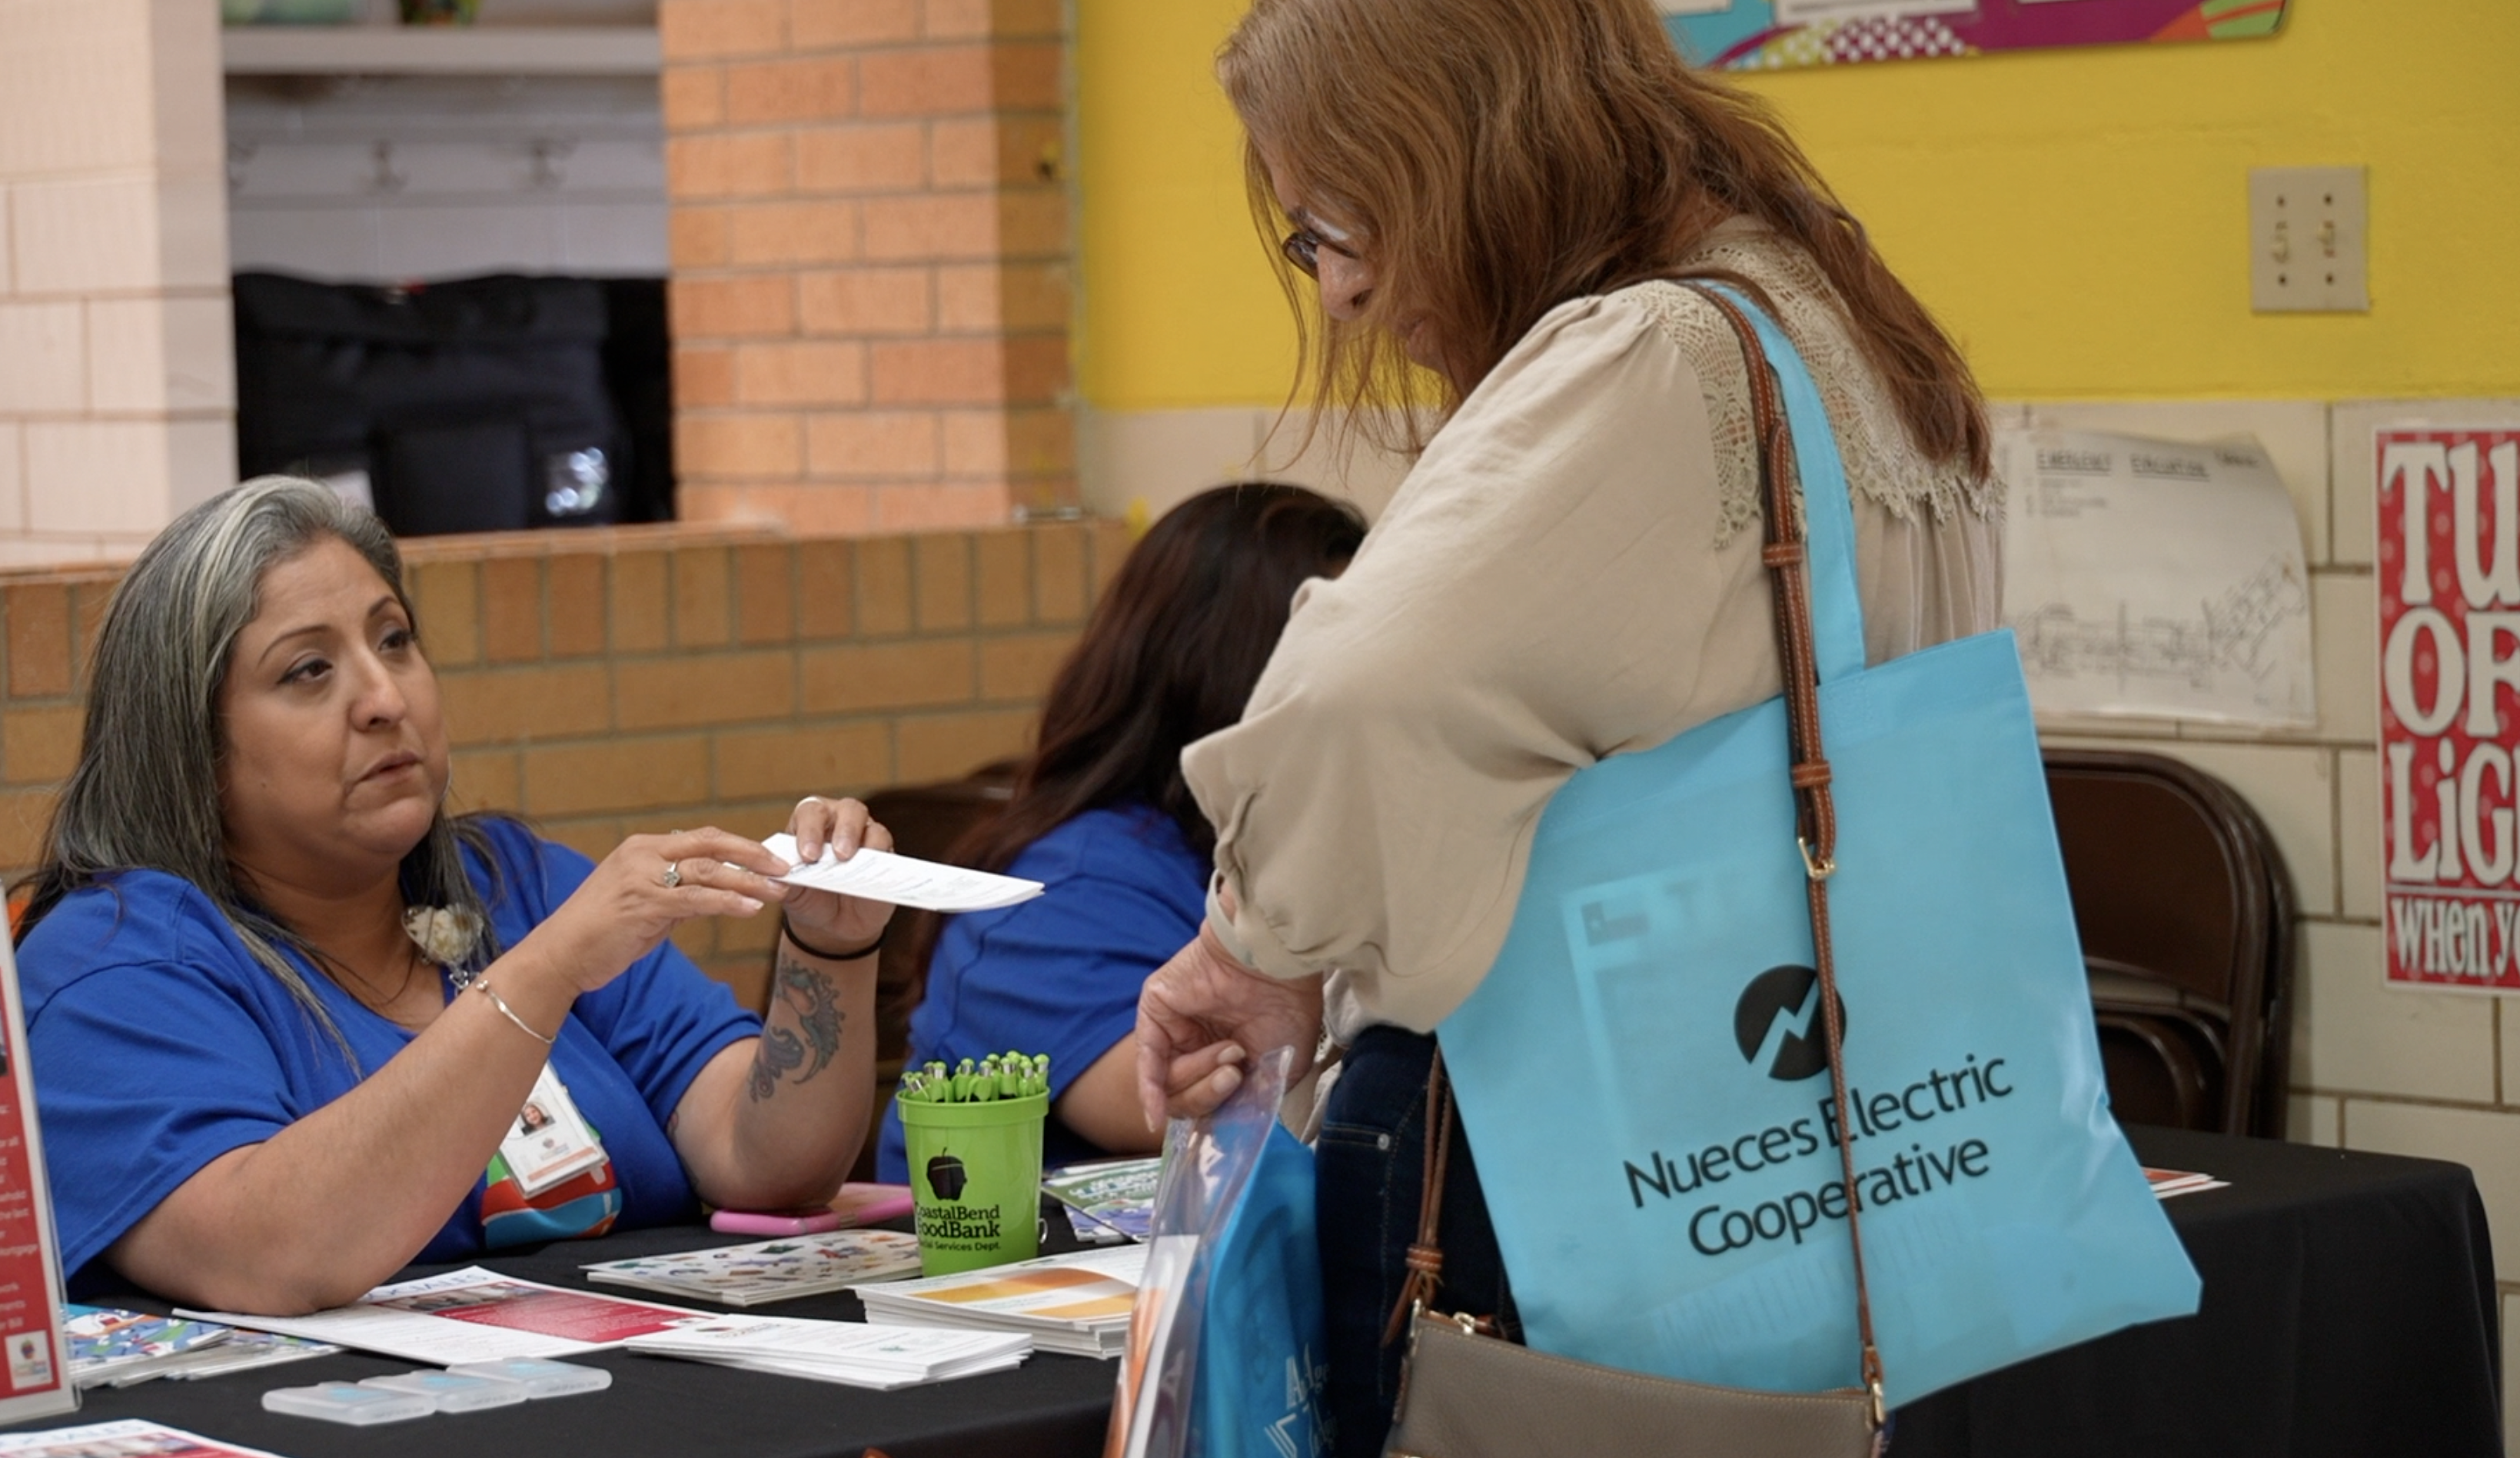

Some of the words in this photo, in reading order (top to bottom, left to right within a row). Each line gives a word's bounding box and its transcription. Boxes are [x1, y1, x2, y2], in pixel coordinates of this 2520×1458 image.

[2383, 440, 2520, 610] TU
[2388, 737, 2520, 886] LiG
[1623, 1117, 1819, 1210] Nueces
[1818, 1054, 2013, 1148] Electric
[1688, 1137, 1990, 1257] Cooperative
[935, 1240, 972, 1252] Services
